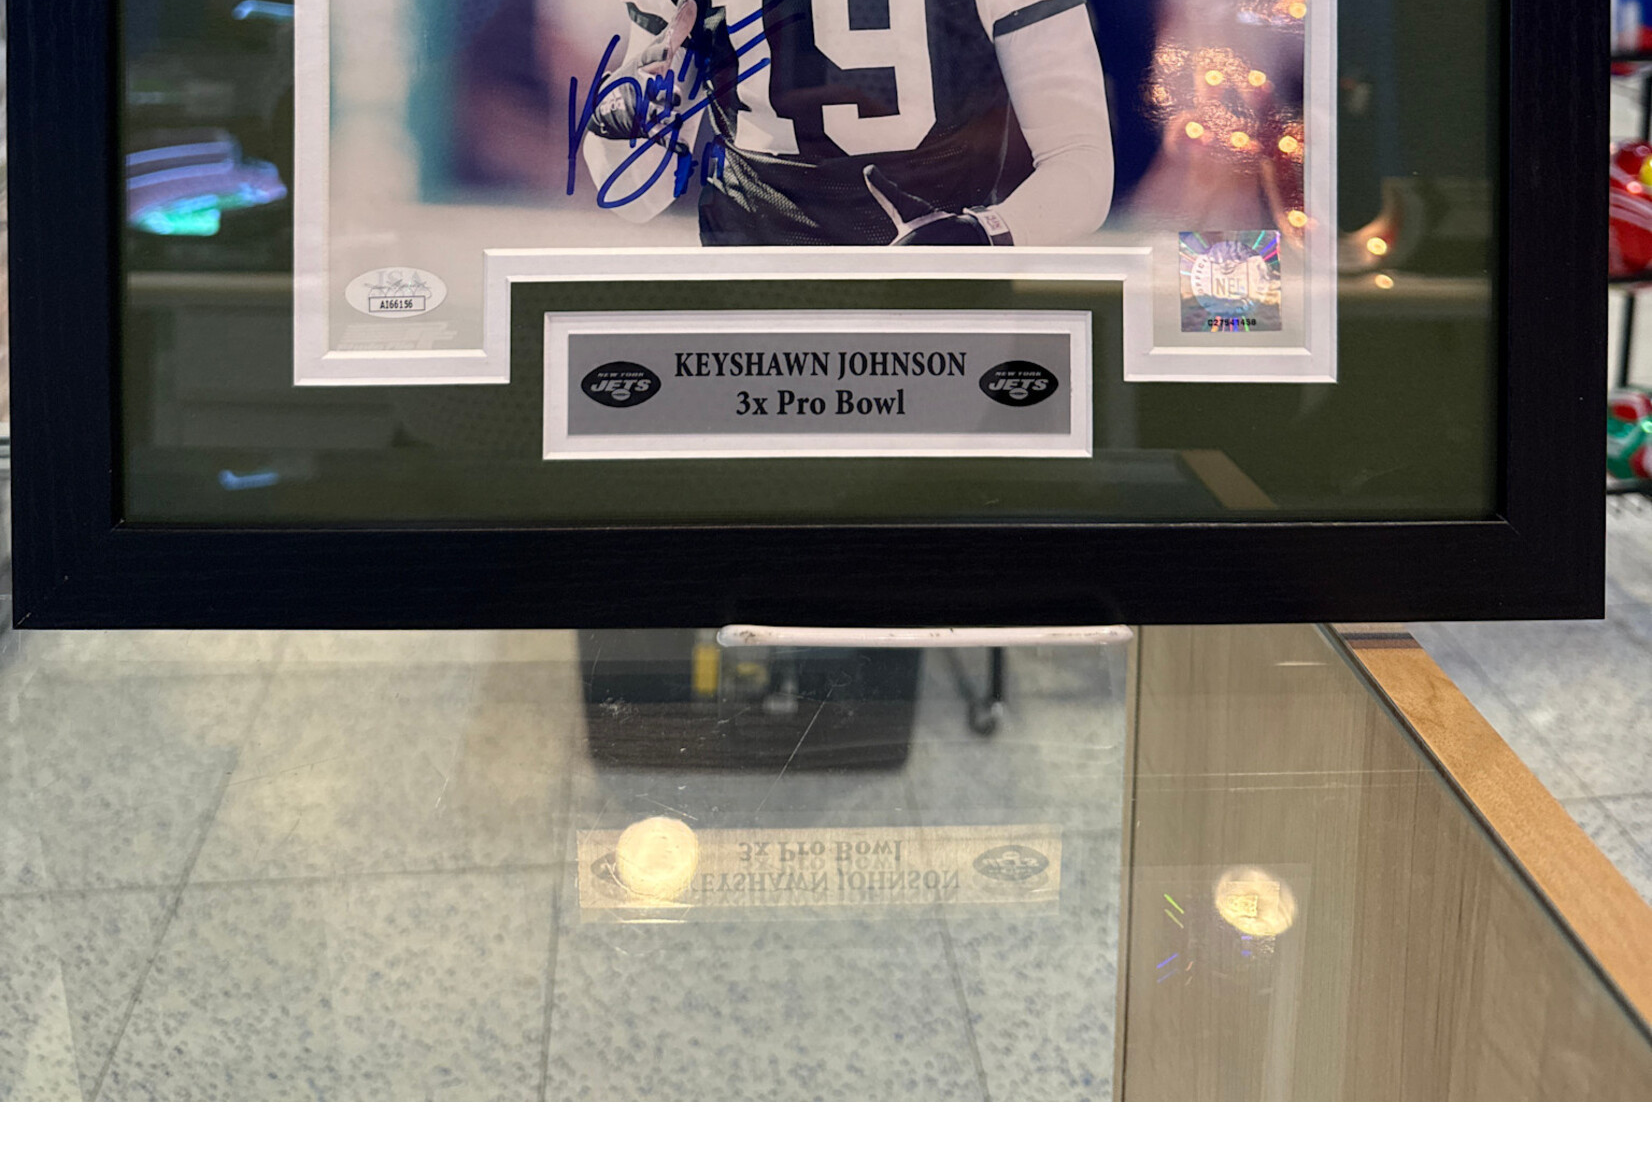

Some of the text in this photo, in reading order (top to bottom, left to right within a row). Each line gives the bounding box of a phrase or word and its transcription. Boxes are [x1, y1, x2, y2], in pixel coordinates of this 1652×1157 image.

[674, 352, 967, 380] KEYSHAWN JOHNSON
[590, 379, 652, 392] JETS
[988, 378, 1049, 391] JETS
[736, 389, 905, 415] 3x Pro Bowl
